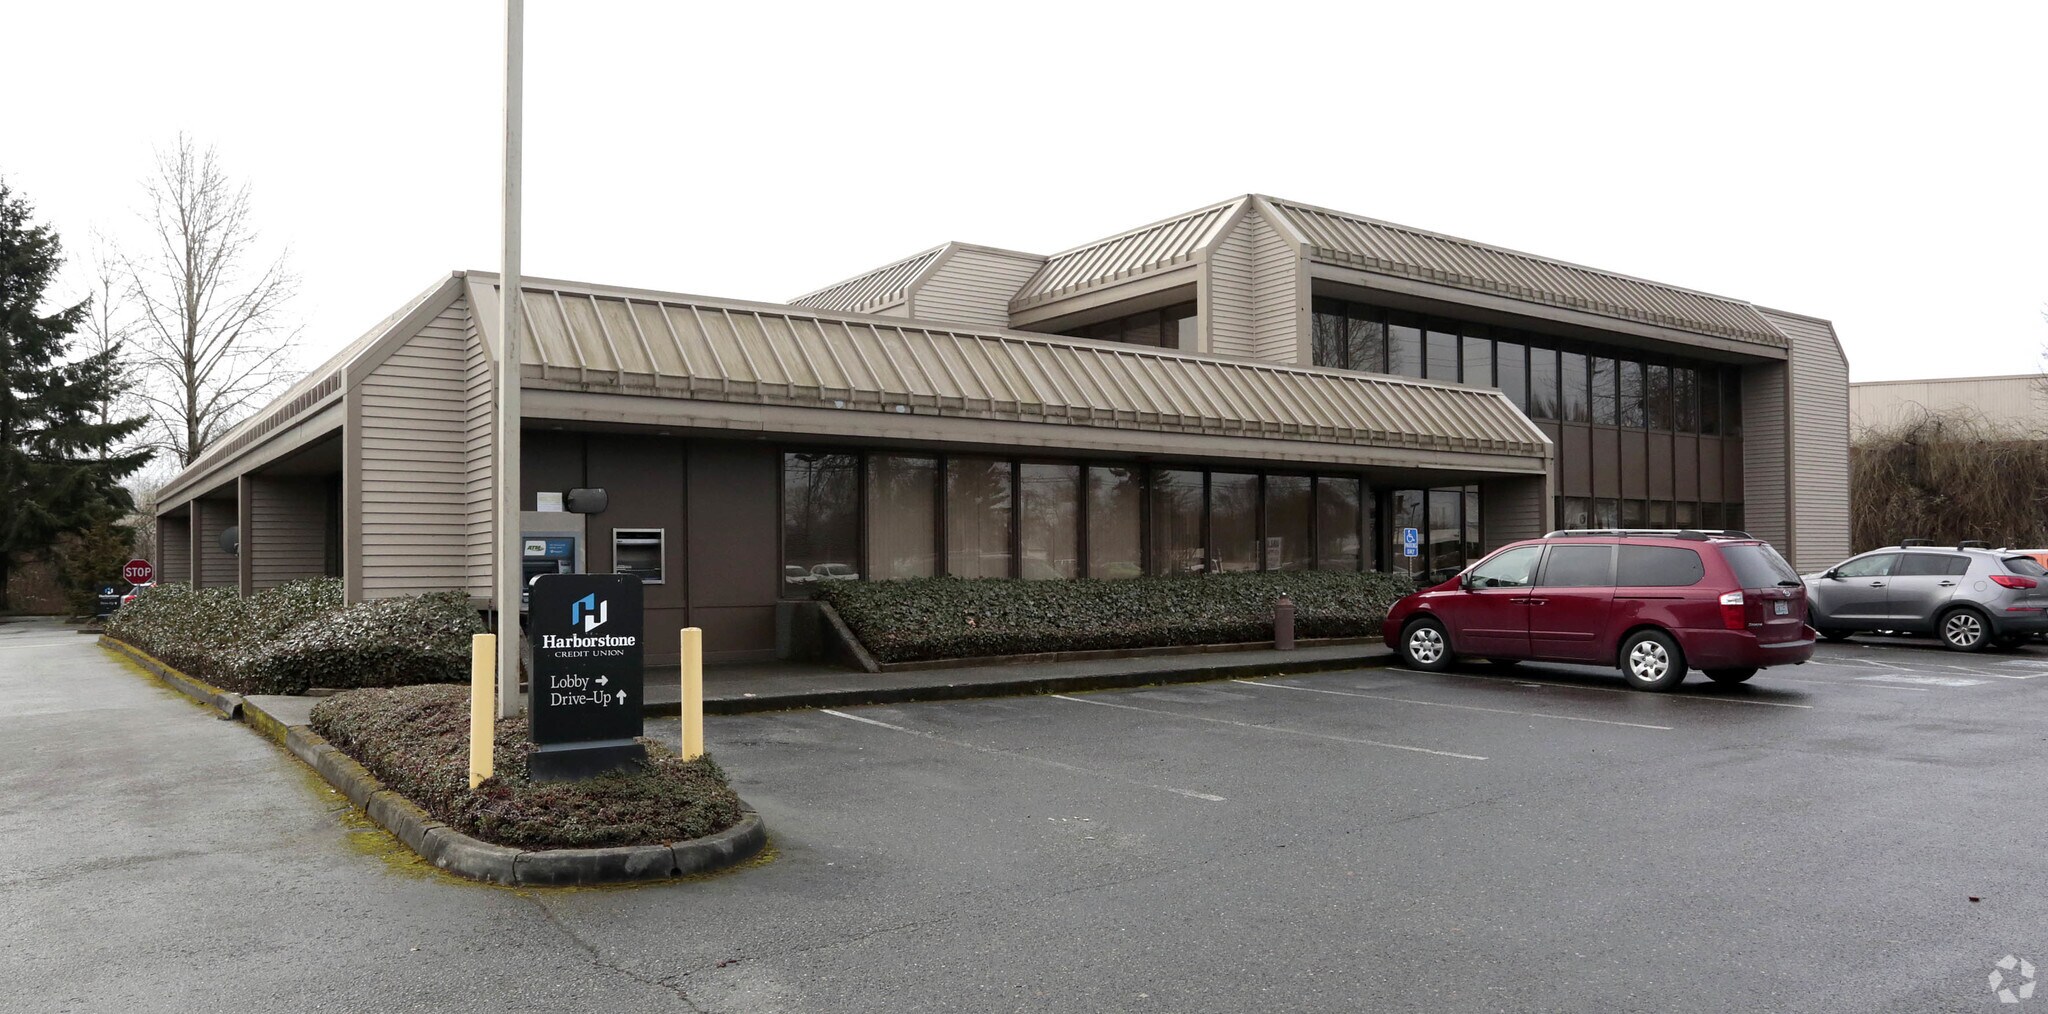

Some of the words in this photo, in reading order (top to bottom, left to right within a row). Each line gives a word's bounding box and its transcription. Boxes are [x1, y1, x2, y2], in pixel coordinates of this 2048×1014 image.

[125, 567, 151, 577] STOP
[542, 633, 636, 649] Harborstone
[554, 650, 590, 658] CREDIT
[592, 649, 625, 657] UNION
[550, 674, 590, 691] Lobby
[550, 690, 612, 707] Drive-Up
